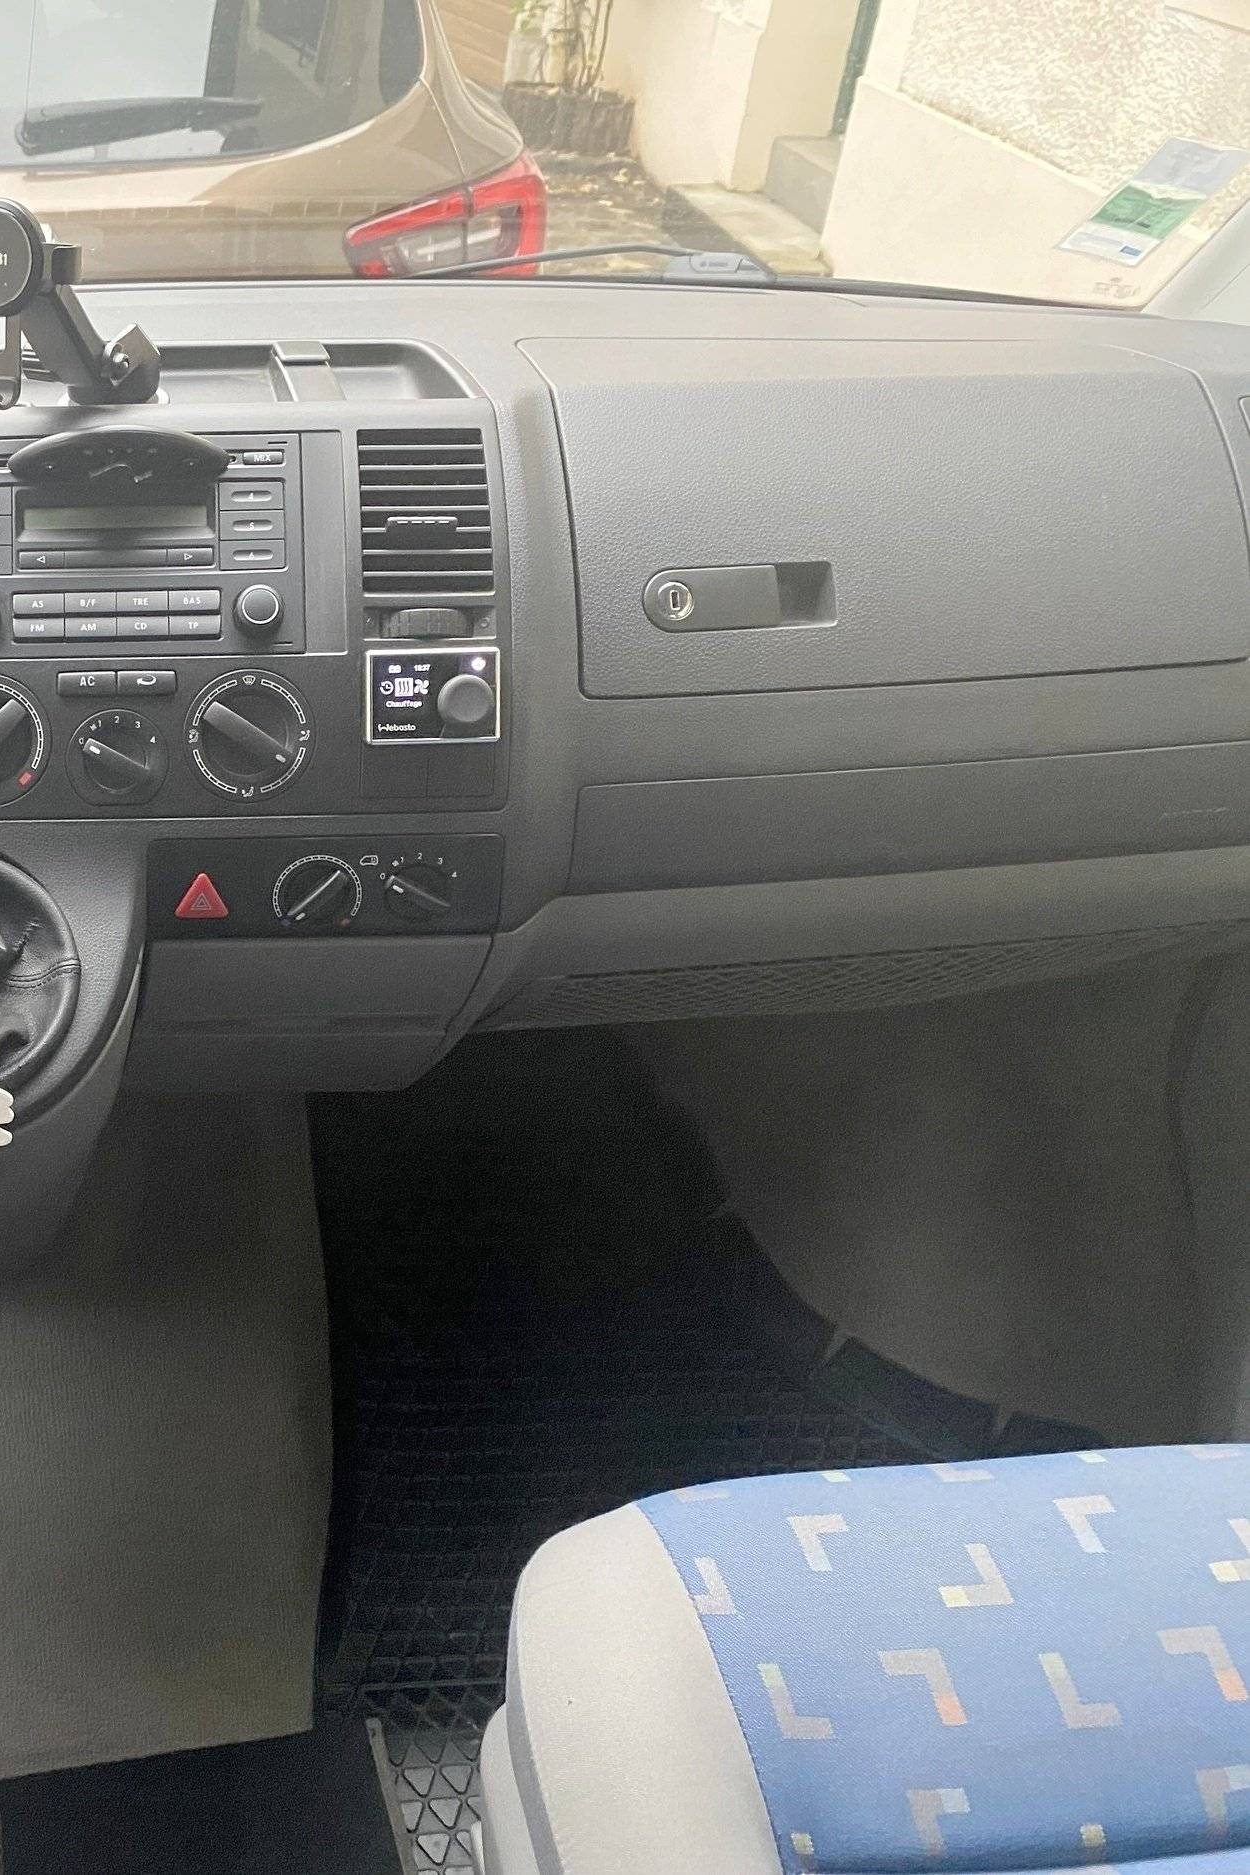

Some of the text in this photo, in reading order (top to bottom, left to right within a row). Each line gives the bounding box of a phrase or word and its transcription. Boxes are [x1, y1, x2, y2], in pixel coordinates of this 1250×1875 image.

[32, 600, 44, 608] AS
[133, 598, 149, 606] TRE
[183, 597, 201, 605] BAS
[30, 621, 199, 632] FM AM CD TP
[79, 676, 95, 686] AC
[385, 700, 423, 708] Chauffage
[114, 715, 120, 723] 2
[135, 721, 141, 729] 3
[150, 736, 156, 744] 4
[437, 857, 443, 865] 3
